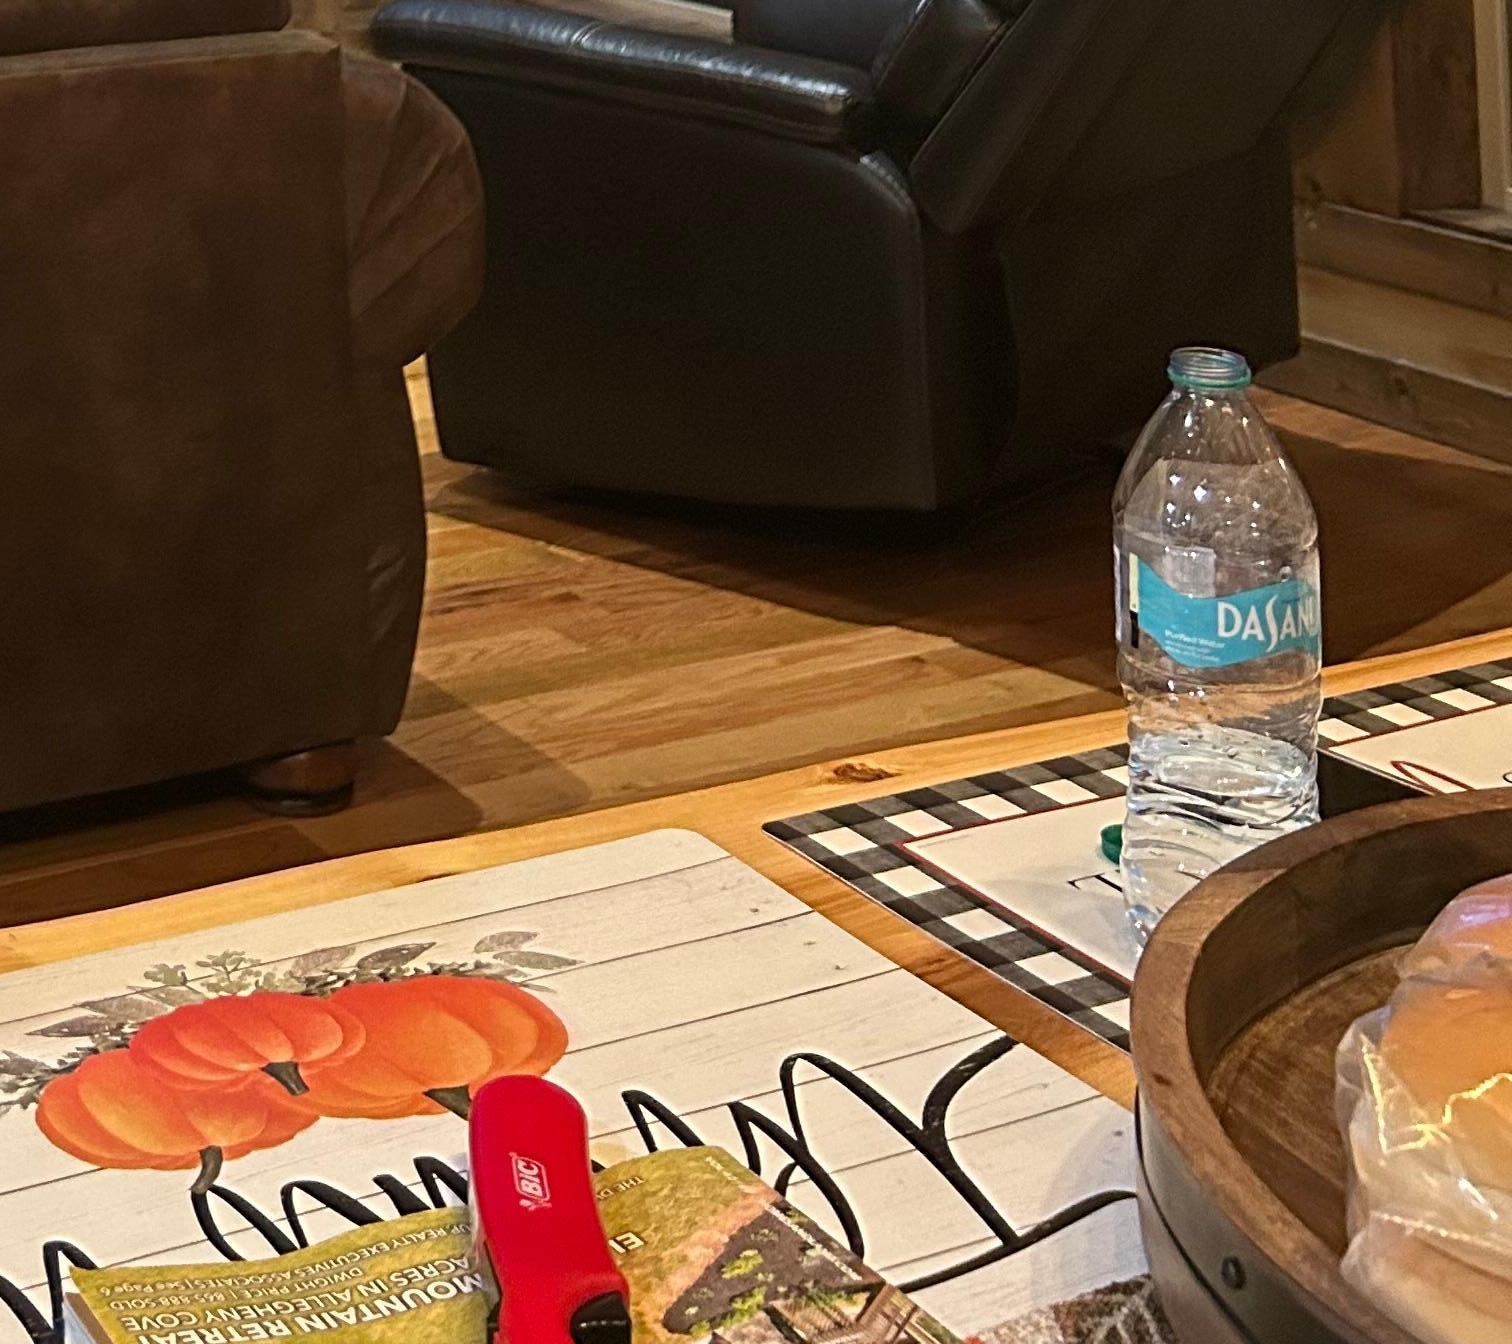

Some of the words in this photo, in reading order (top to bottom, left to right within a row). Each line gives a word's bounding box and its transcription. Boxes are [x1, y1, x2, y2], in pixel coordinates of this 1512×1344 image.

[517, 1159, 543, 1197] BIC
[614, 1176, 645, 1192] THE
[391, 1227, 448, 1250] REALTY
[294, 1241, 391, 1278] EXECUTIVES
[389, 1255, 470, 1287] ACRES
[195, 1270, 292, 1290] ASSOCIATES
[291, 1266, 364, 1293] DWIGHT
[356, 1279, 389, 1298] IN
[241, 1285, 290, 1300] PRICE
[294, 1272, 483, 1333] MOUNTAIN
[205, 1288, 352, 1324] ALLEGHENY
[119, 1311, 199, 1332] COVE
